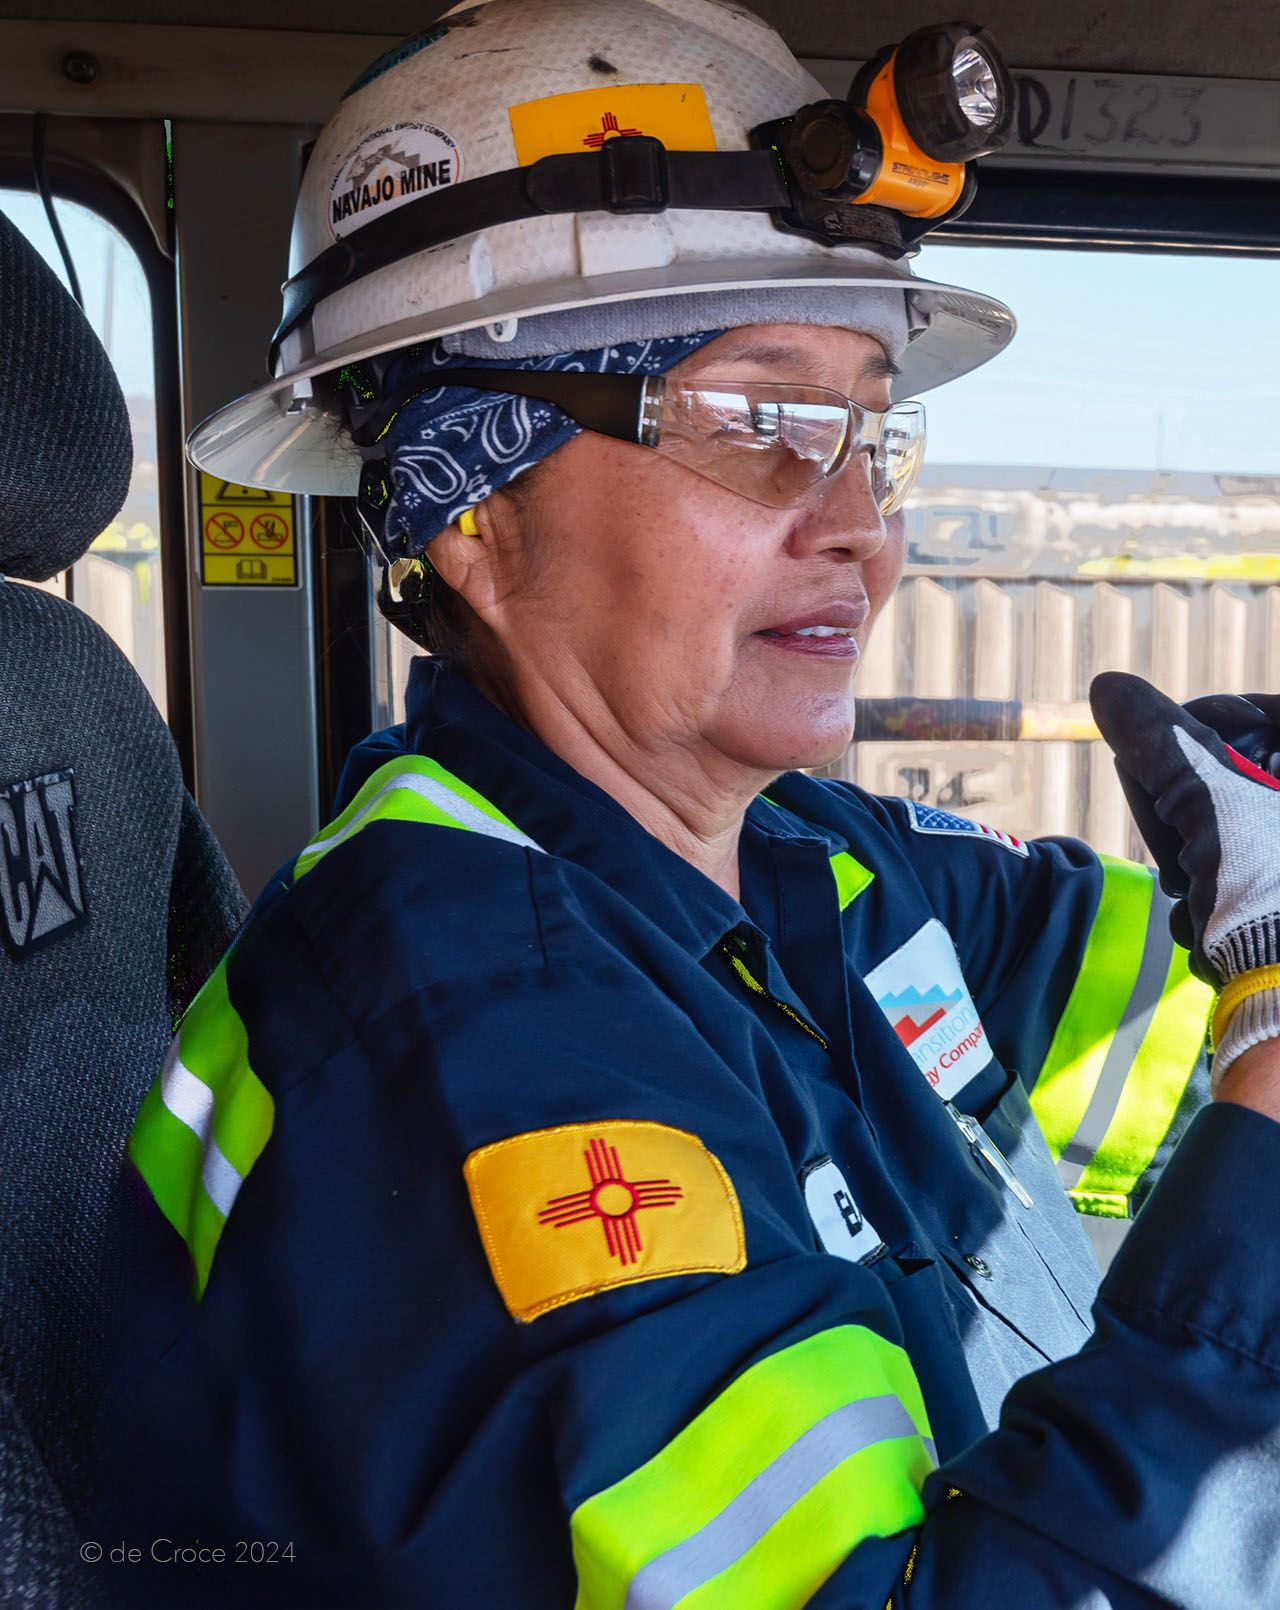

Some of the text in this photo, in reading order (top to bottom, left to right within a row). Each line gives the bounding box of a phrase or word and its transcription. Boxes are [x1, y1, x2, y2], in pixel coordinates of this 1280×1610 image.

[424, 125, 455, 148] COMPANY
[332, 159, 451, 224] NAVAJO MINE
[0, 780, 84, 946] CAT
